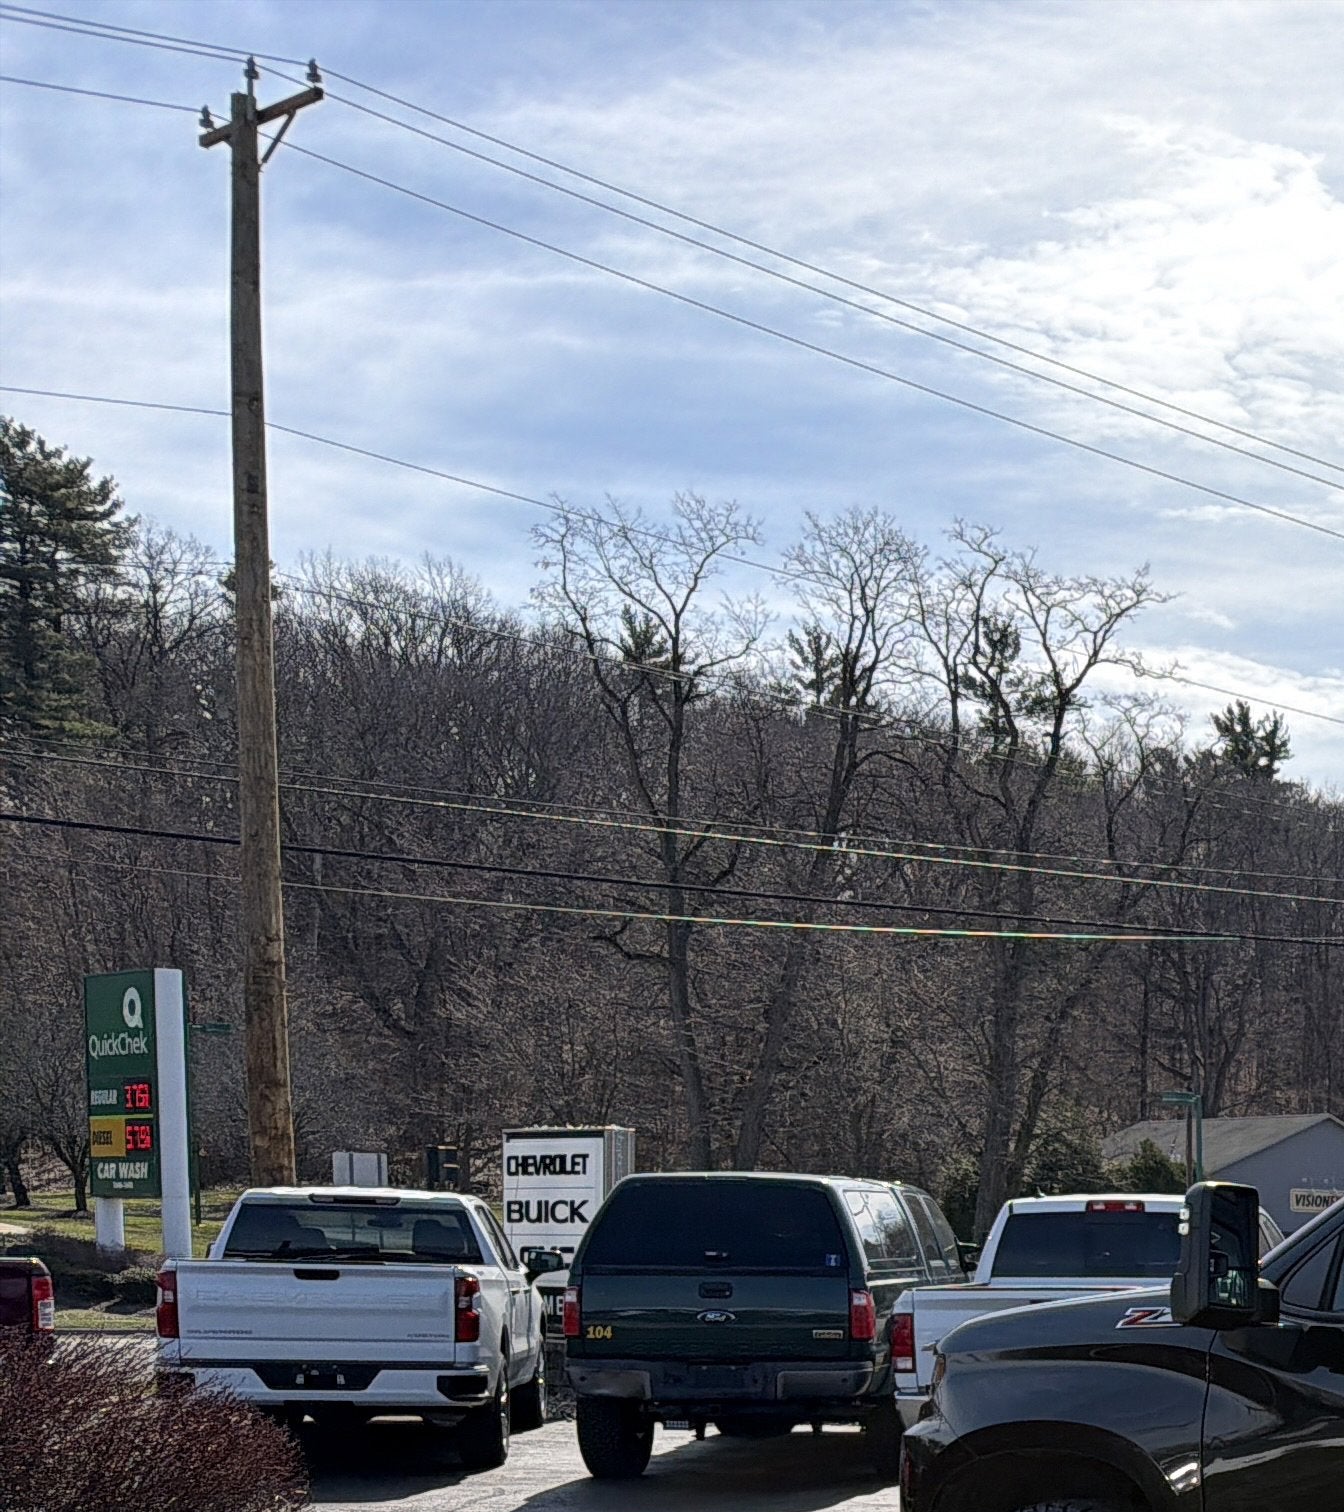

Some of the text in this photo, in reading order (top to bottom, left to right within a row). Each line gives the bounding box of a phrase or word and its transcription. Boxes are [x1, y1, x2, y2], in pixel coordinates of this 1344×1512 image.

[88, 1030, 148, 1060] QuickChek
[97, 1162, 149, 1180] CAR WASH
[506, 1153, 589, 1176] CHEVROLET
[506, 1199, 589, 1224] BUICK
[586, 1325, 613, 1339] 104
